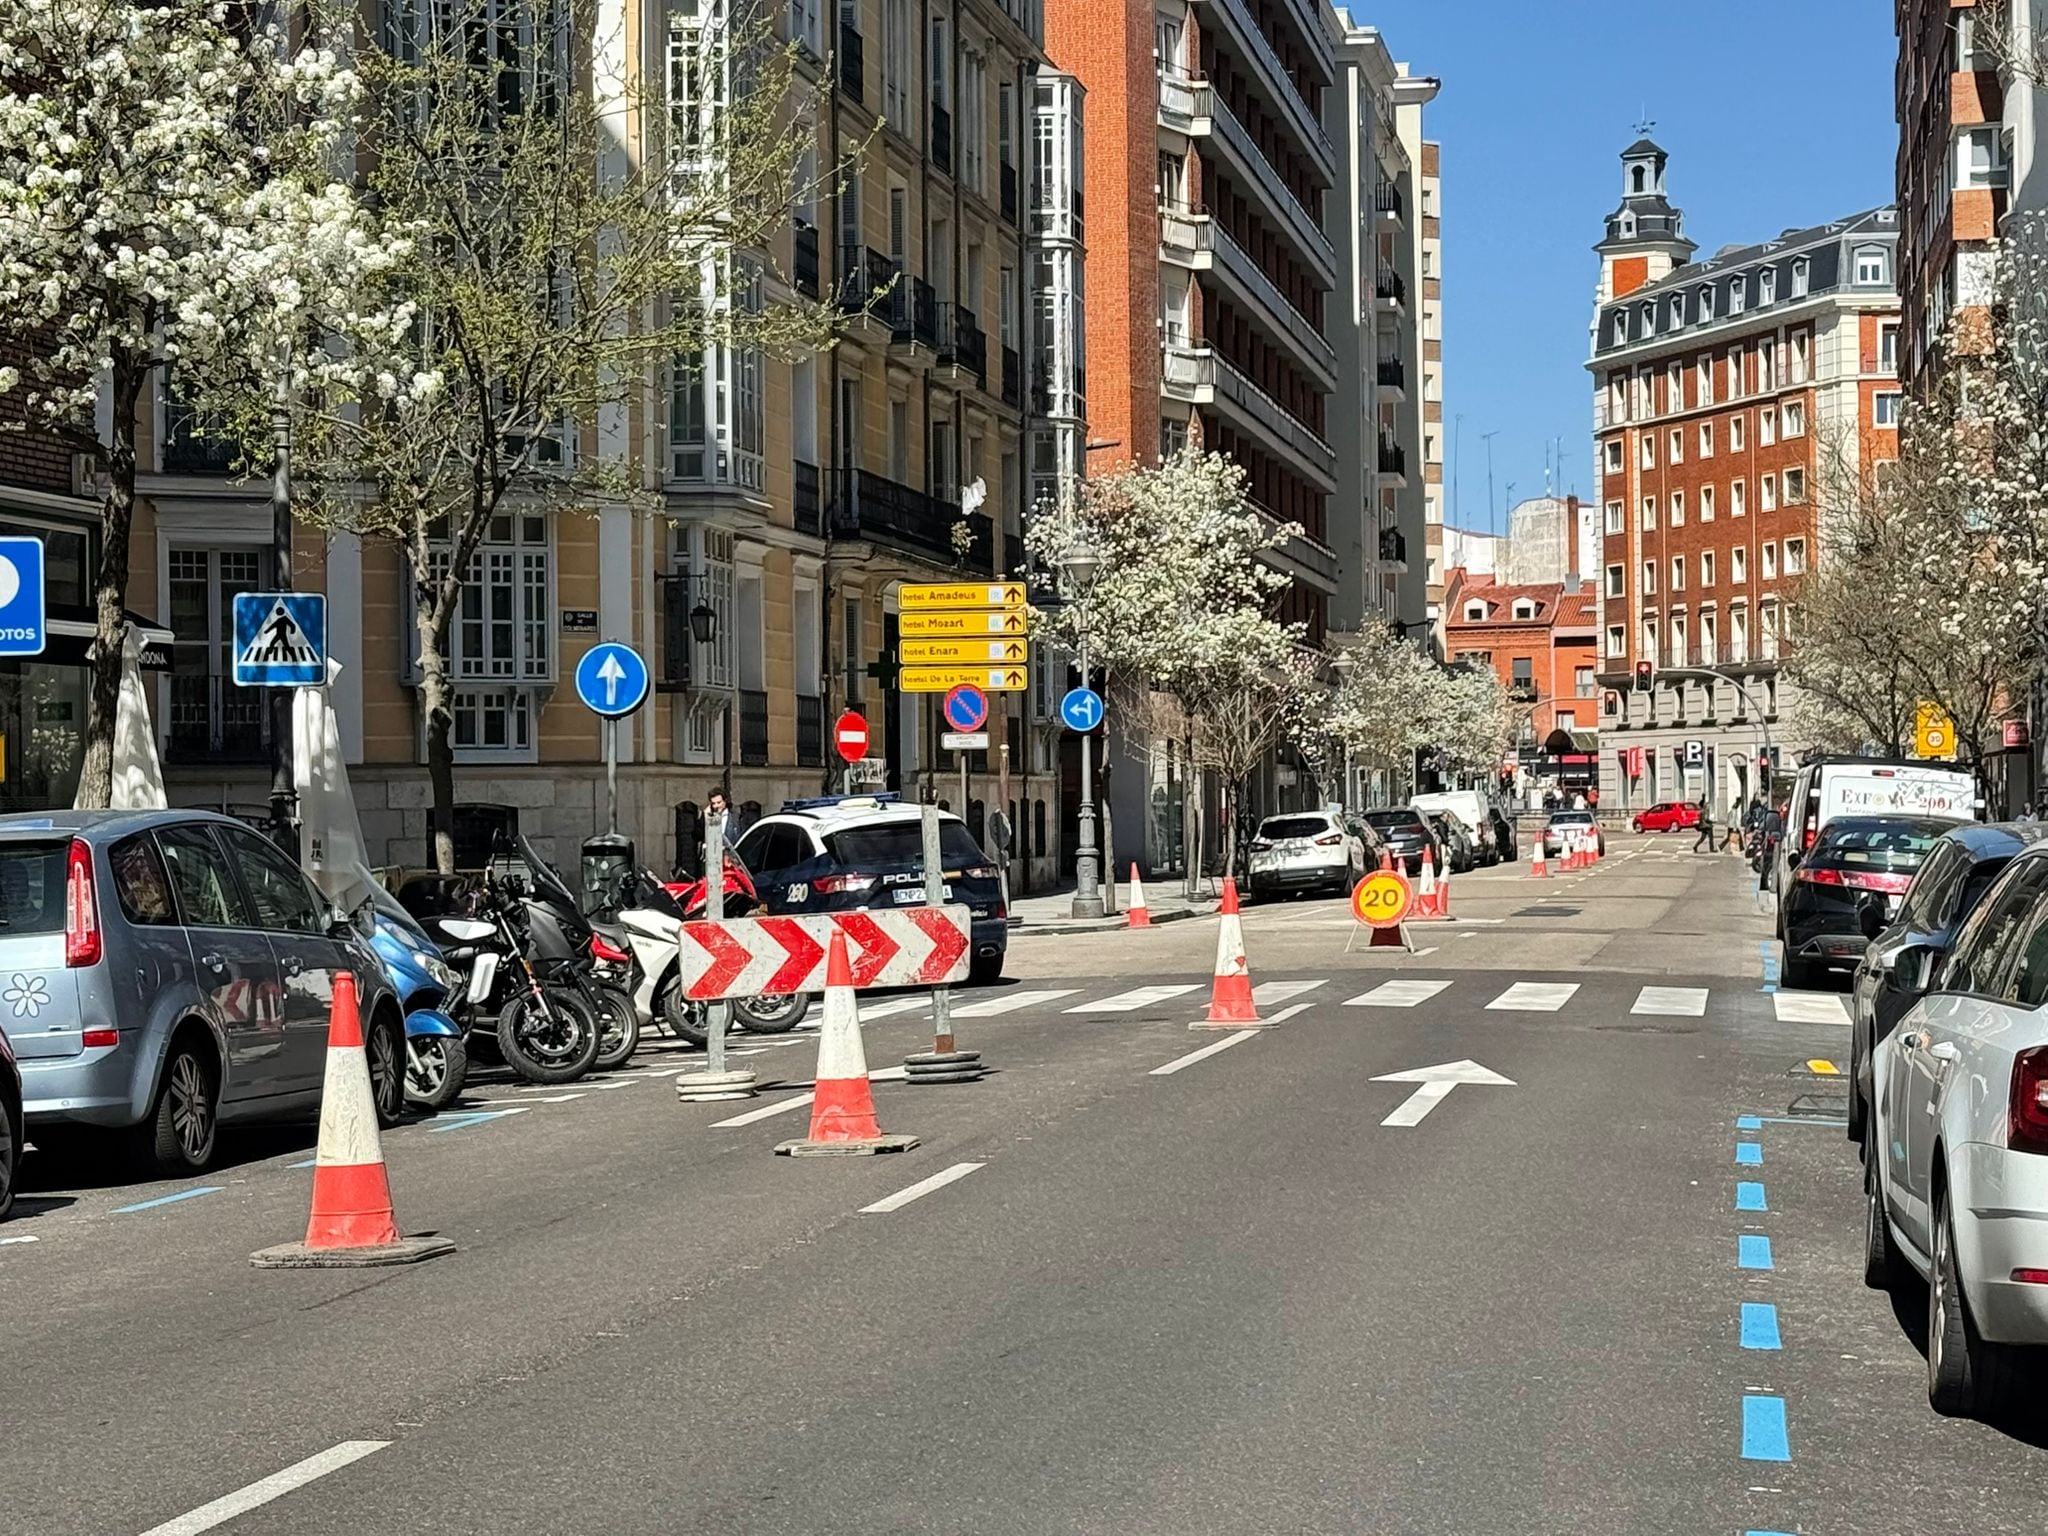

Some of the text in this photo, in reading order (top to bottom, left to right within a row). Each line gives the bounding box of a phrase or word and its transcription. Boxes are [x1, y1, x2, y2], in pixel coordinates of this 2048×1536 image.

[903, 591, 976, 601] hotel Amadeus
[903, 618, 965, 629] hotel Mozart
[904, 646, 959, 656] hotel Enara
[945, 674, 955, 683] La
[959, 673, 980, 683] Torre
[1364, 888, 1399, 908] 20
